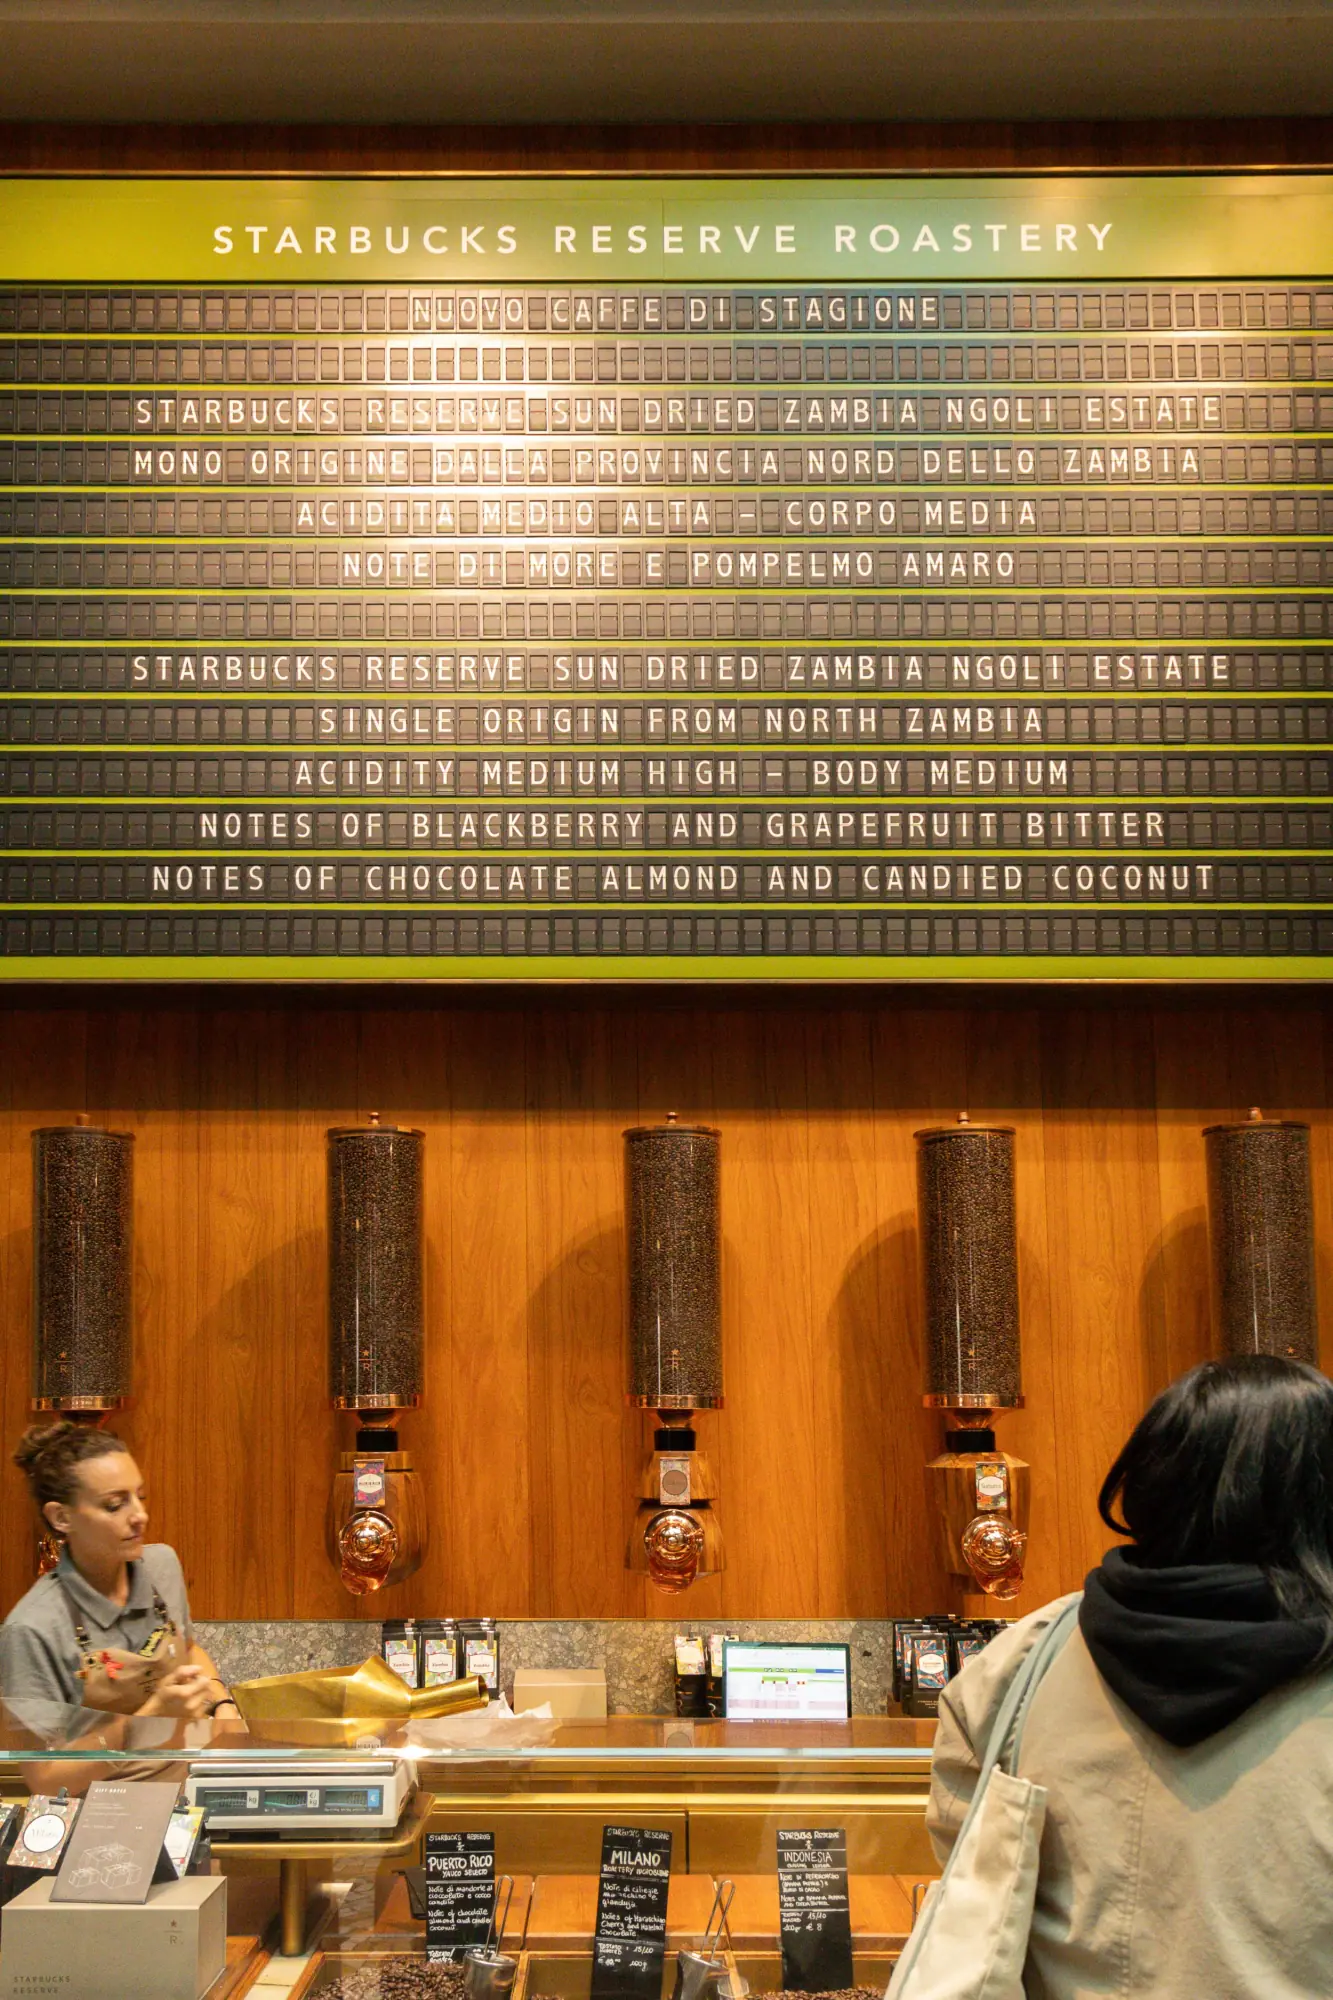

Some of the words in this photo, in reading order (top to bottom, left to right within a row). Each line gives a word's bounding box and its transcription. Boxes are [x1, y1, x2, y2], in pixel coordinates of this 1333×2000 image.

[212, 226, 517, 253] STARBUCKS
[553, 224, 797, 253] RESERVE
[835, 223, 1114, 252] ROASTERY
[412, 296, 525, 325] NUOVO
[551, 296, 660, 324] CAFFE
[689, 296, 726, 323] DI
[757, 295, 938, 323] STAGIONE
[134, 397, 339, 426] STARBUCKS
[365, 397, 524, 426] RESERVE
[552, 397, 618, 426] SUN
[644, 397, 755, 426] DRIED
[782, 397, 918, 426] ZAMBIA
[945, 396, 1053, 425] NGOLI
[1085, 396, 1222, 424] ESTATE
[133, 449, 223, 476] MONO
[249, 449, 408, 477] ORIGINE
[435, 449, 548, 477] DALLA
[575, 448, 779, 477] PROVINCIA
[806, 448, 895, 476] NORD
[921, 448, 1036, 476] DELLO
[1063, 447, 1199, 474] ZAMBIA
[295, 500, 455, 528] ACIDITA
[481, 500, 595, 528] MEDIO
[622, 498, 710, 528] ALTA
[785, 500, 897, 528] CORPO
[924, 500, 1037, 528] MEDIA
[342, 552, 431, 580] NOTE
[458, 552, 497, 580] DI
[529, 551, 617, 579] MORE
[646, 552, 663, 579] E
[692, 551, 875, 579] POMPELMO
[902, 551, 1016, 579] AMARO
[132, 654, 338, 684] STARBUCKS
[365, 654, 525, 684] RESERVE
[553, 654, 620, 684] SUN
[645, 654, 760, 682] DRIED
[788, 654, 924, 682] ZAMBIA
[951, 653, 1060, 682] NGOLI
[1094, 653, 1229, 681] ESTATE
[319, 707, 454, 735] SINGLE
[482, 707, 620, 735] ORIGIN
[647, 706, 737, 735] FROM
[764, 706, 877, 734] NORTH
[906, 706, 1043, 734] ZAMBIA
[294, 759, 454, 786] ACIDITY
[482, 759, 620, 786] MEDIUM
[647, 758, 738, 786] HIGH
[812, 758, 902, 786] BODY
[929, 758, 1069, 786] MEDIUM
[199, 811, 313, 839] NOTES
[340, 811, 383, 839] OF
[411, 811, 644, 839] BLACKBERRY
[671, 811, 737, 839] AND
[765, 811, 997, 839] GRAPEFRUIT
[1026, 811, 1166, 839] BITTER
[151, 864, 266, 892] NOTES
[293, 864, 336, 892] OF
[365, 864, 572, 892] CHOCOLATE
[600, 864, 738, 892] ALMOND
[766, 864, 834, 892] AND
[862, 864, 1024, 892] CANDIED
[1051, 864, 1215, 892] COCONUT
[249, 1796, 257, 1804] kg
[427, 1857, 467, 1872] PUERTO
[469, 1854, 493, 1867] RICO
[610, 1850, 661, 1867] MILANO
[784, 1852, 833, 1863] INDONESIA
